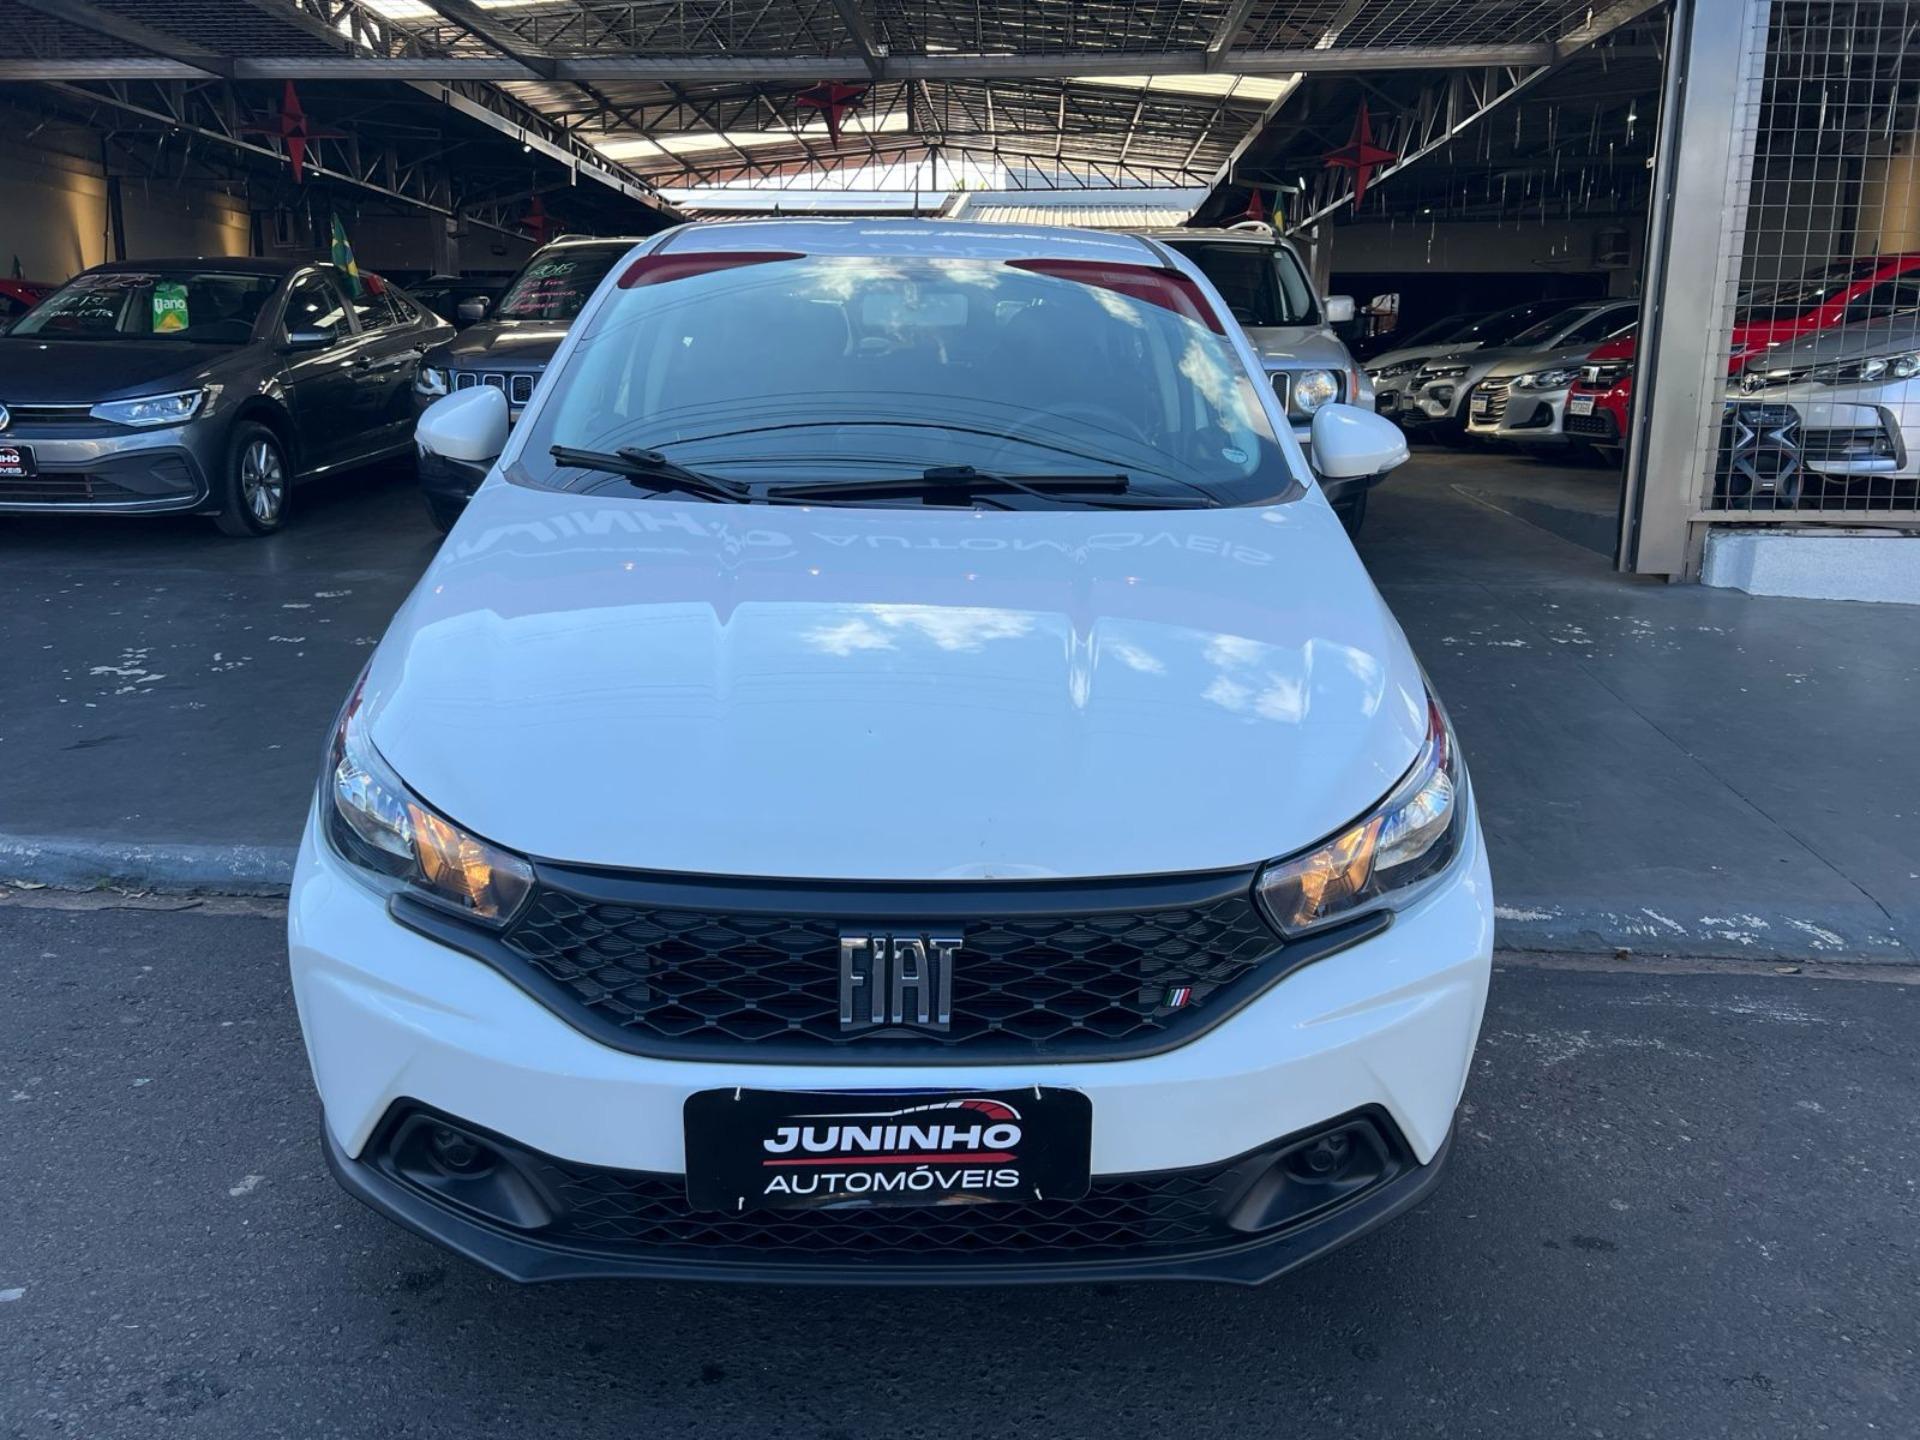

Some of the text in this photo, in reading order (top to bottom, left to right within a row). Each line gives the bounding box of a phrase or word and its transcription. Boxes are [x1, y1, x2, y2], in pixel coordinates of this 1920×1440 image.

[840, 937, 963, 1026] FIAT
[763, 1123, 1022, 1153] JUNINHO
[763, 1165, 1020, 1195] AUTOMÓVEIS
